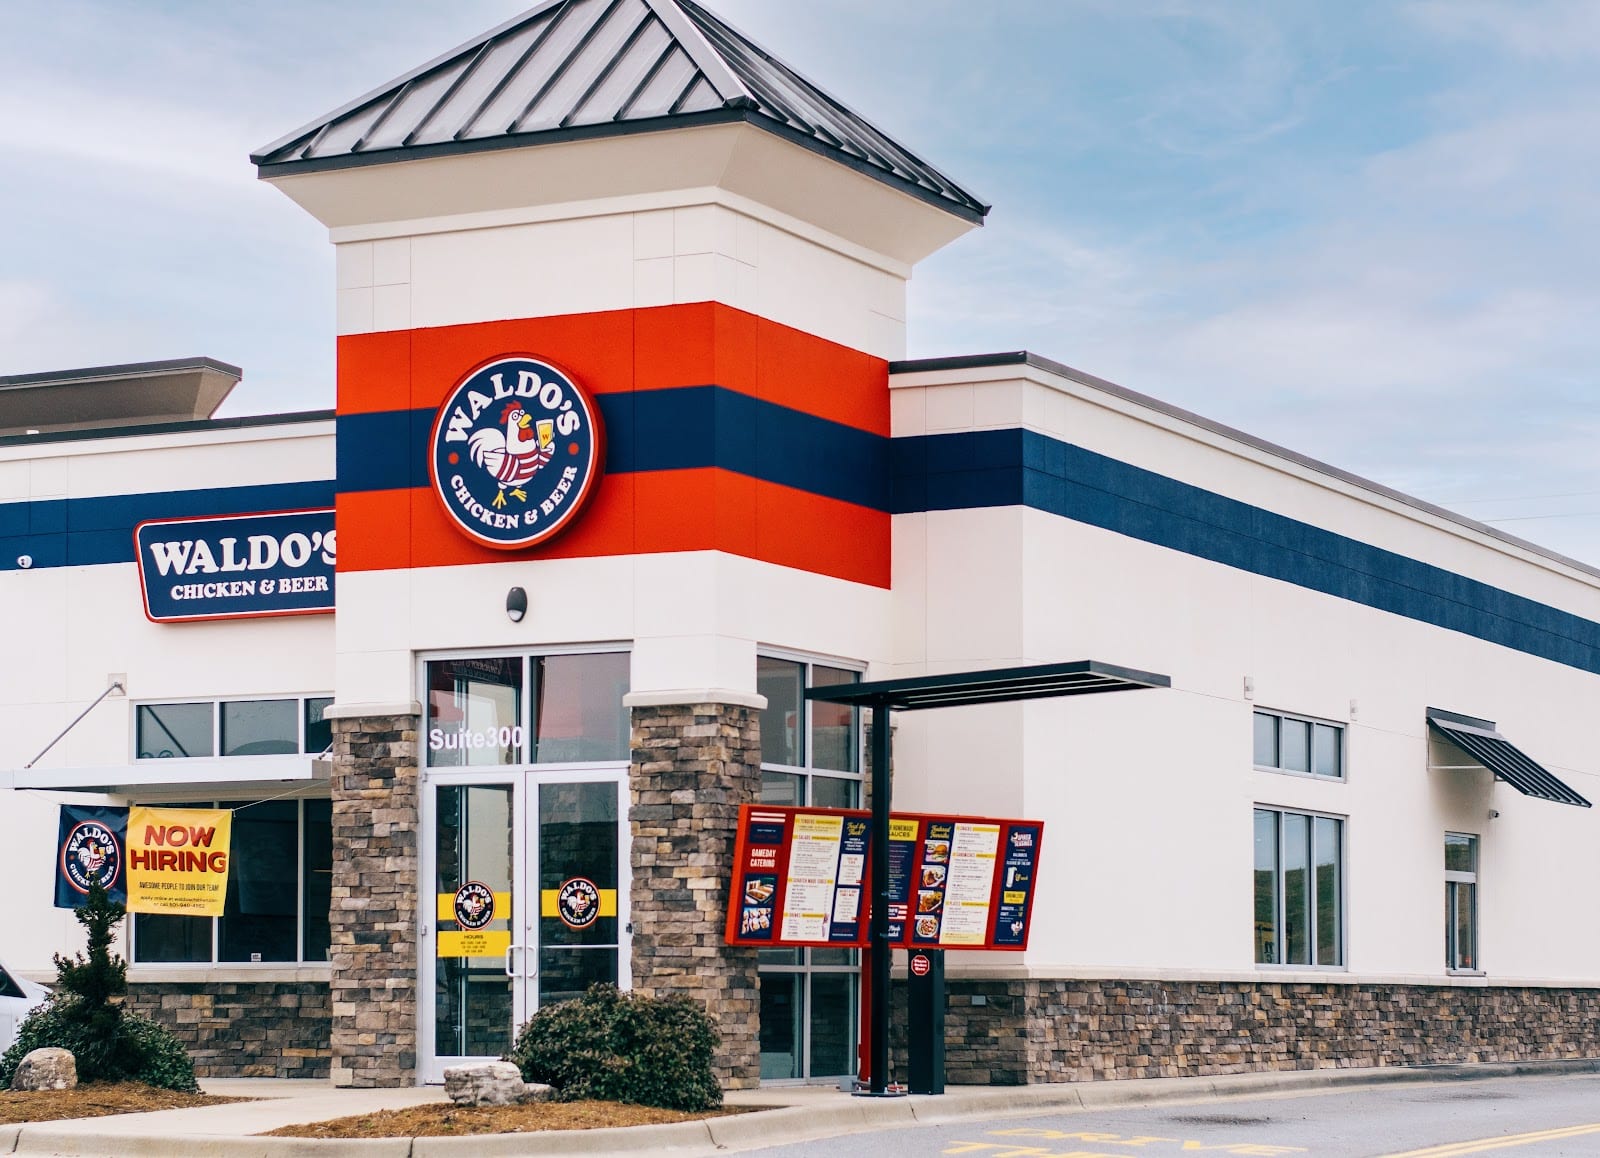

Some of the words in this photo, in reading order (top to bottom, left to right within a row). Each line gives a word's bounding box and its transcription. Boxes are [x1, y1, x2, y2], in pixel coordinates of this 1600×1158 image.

[445, 370, 581, 442] WALDO'S
[451, 475, 520, 529] CHICKEN
[524, 509, 538, 526] &
[540, 466, 578, 516] BEER
[170, 580, 256, 600] CHICKEN
[259, 579, 275, 595] &
[278, 576, 329, 594] BEER
[69, 827, 115, 854] WALDO'S
[144, 825, 216, 848] NOW
[130, 849, 227, 874] HIRING
[161, 882, 177, 891] PEOPLE
[179, 883, 185, 891] TO
[185, 883, 196, 892] JOIN
[196, 884, 206, 892] OUR
[456, 885, 492, 904] WALDO'S
[560, 881, 597, 900] WALDO'S
